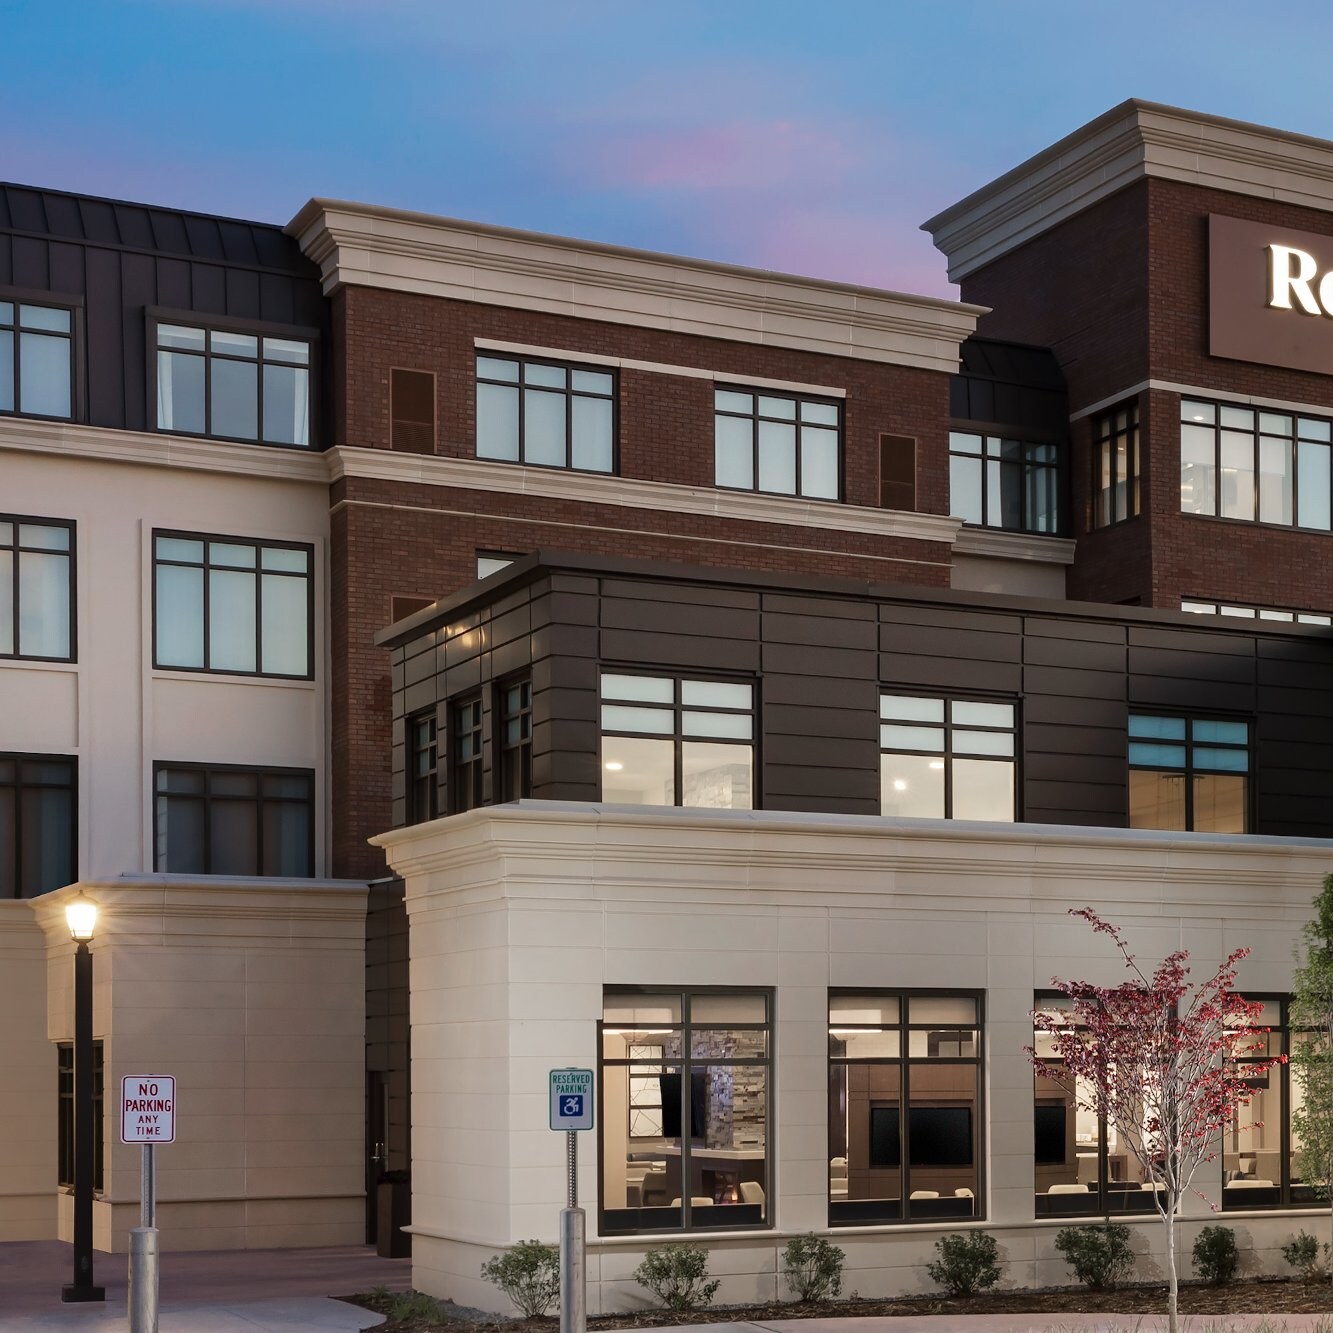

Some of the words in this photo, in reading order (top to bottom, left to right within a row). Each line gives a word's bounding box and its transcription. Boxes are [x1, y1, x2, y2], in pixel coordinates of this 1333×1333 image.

[552, 1074, 590, 1084] RESERVED
[139, 1083, 159, 1097] NO
[556, 1084, 587, 1094] PARKING
[125, 1099, 172, 1112] PARKING
[138, 1114, 159, 1124] ANY
[136, 1126, 161, 1136] TIME
